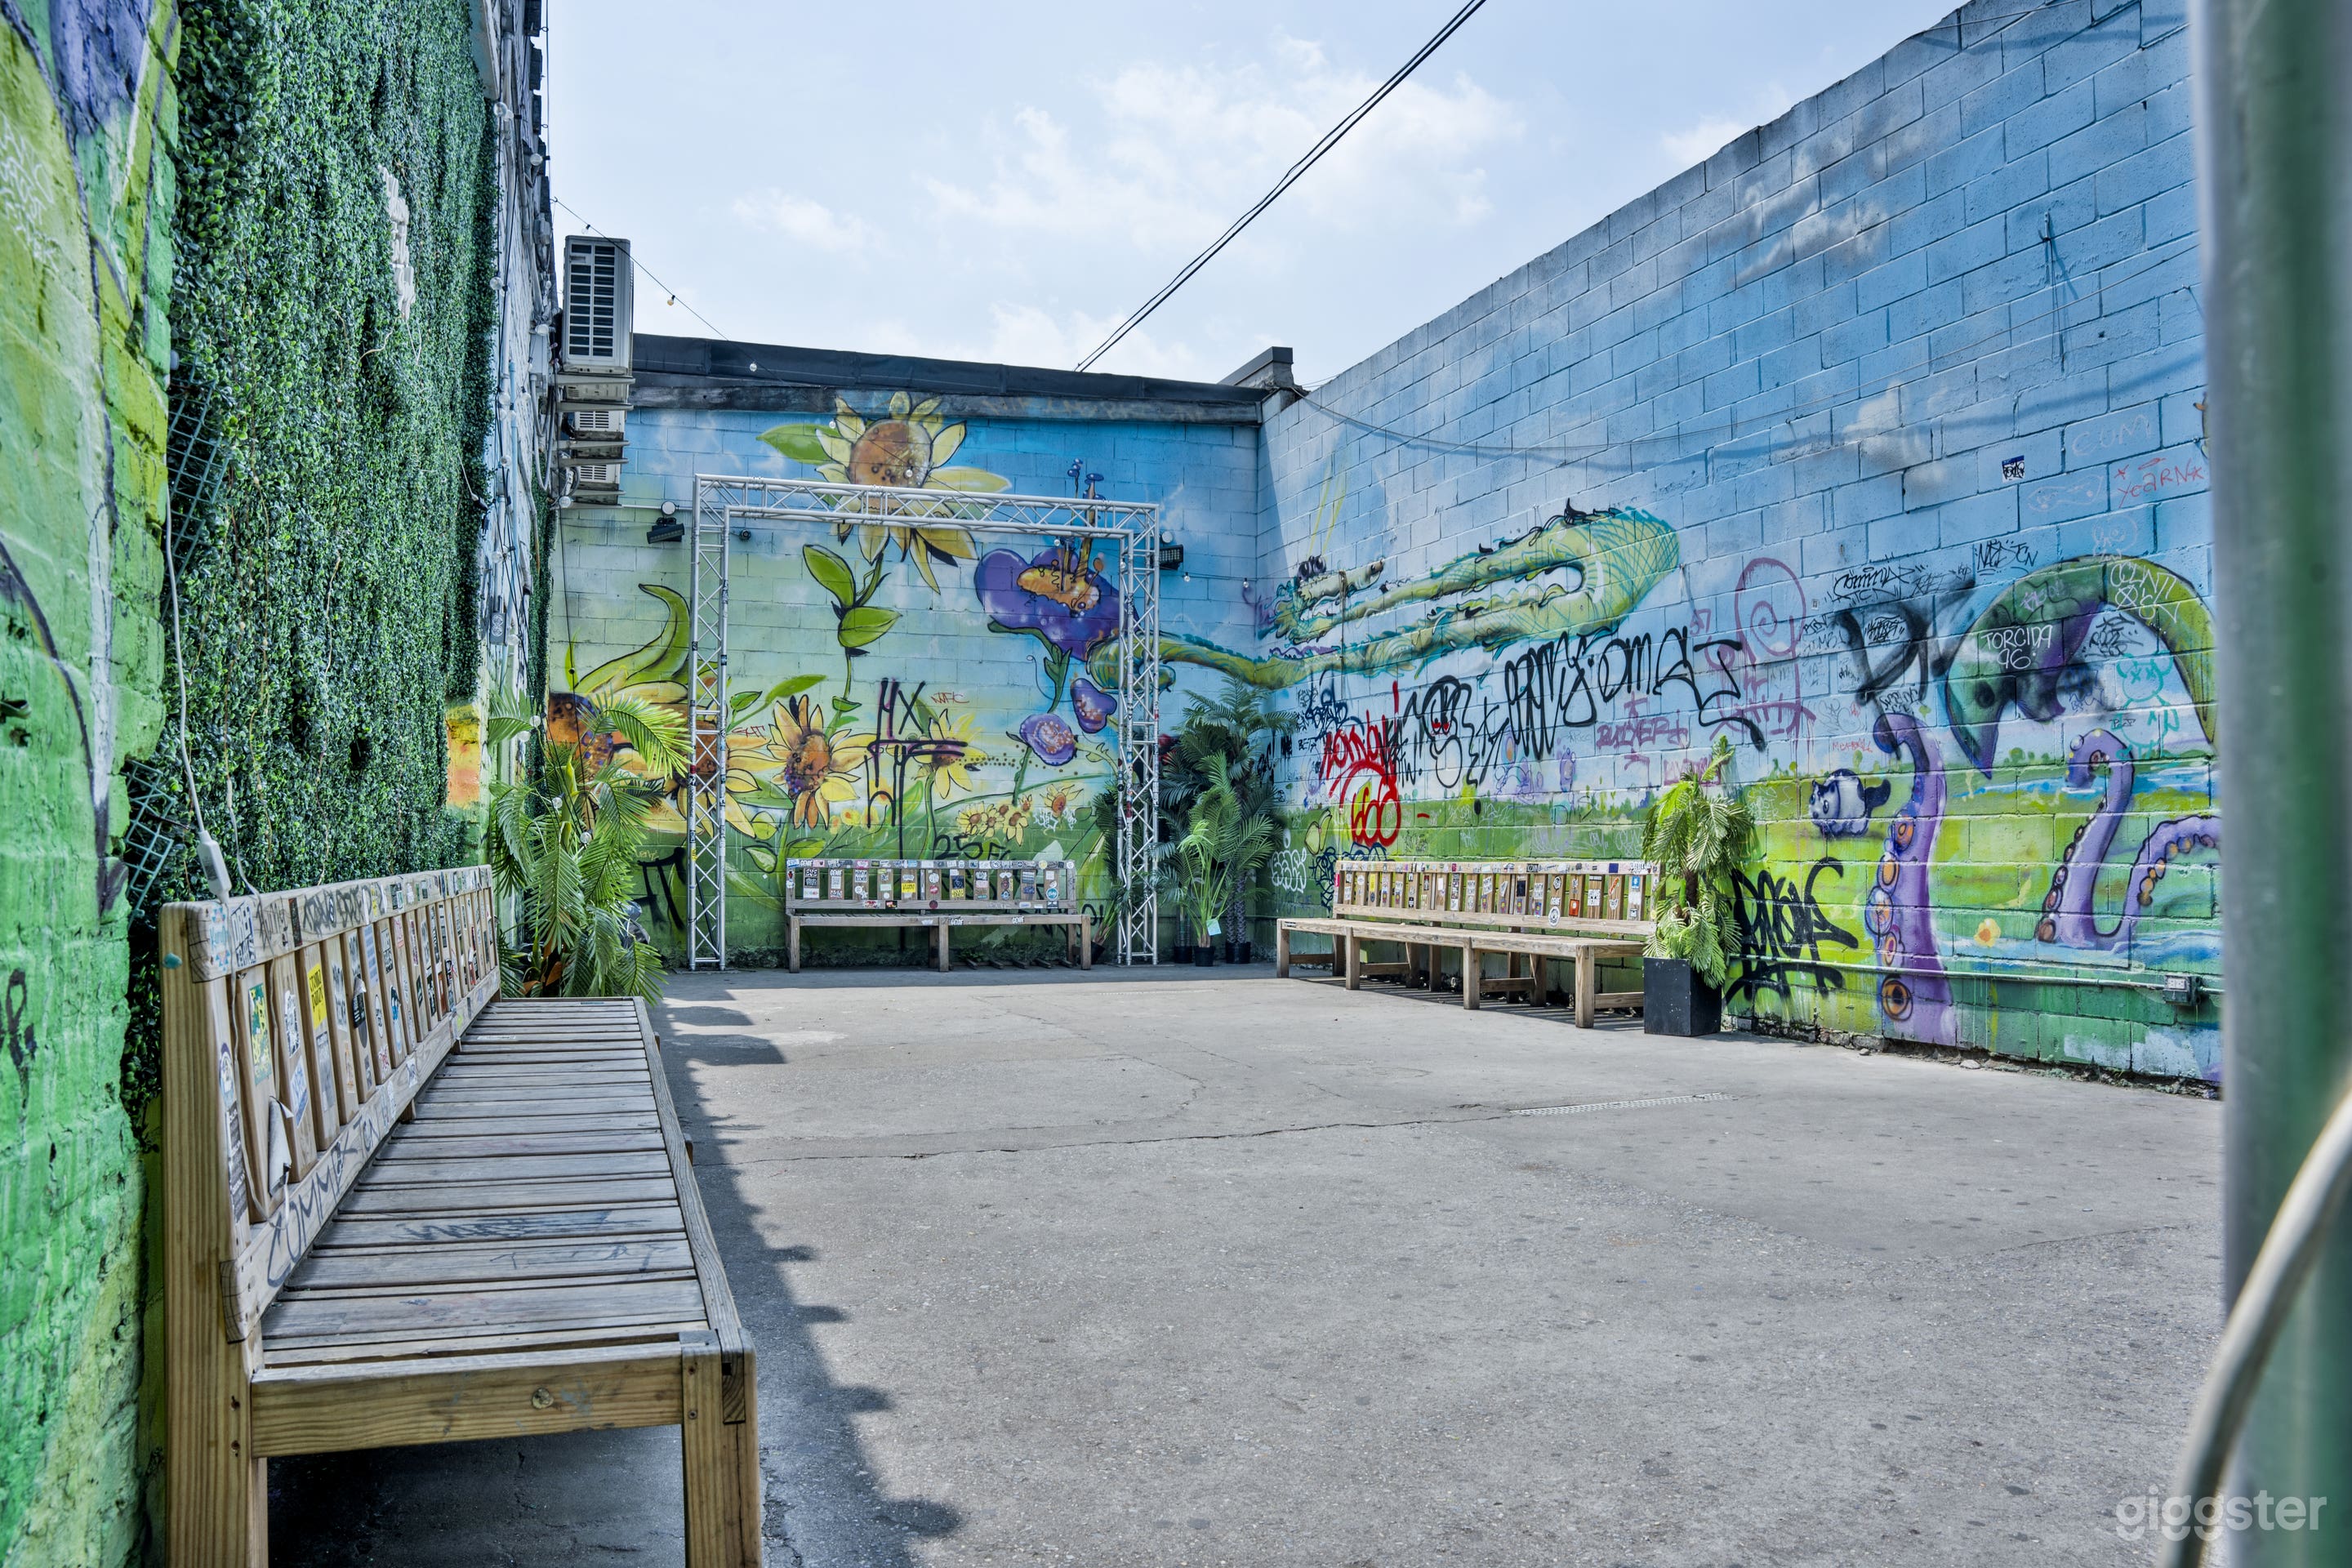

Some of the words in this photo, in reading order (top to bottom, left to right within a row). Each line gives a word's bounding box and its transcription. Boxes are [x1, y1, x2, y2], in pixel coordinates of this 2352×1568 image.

[2072, 413, 2152, 457] CUM
[1980, 624, 2053, 650] TORCIDA
[1997, 648, 2031, 670] 96
